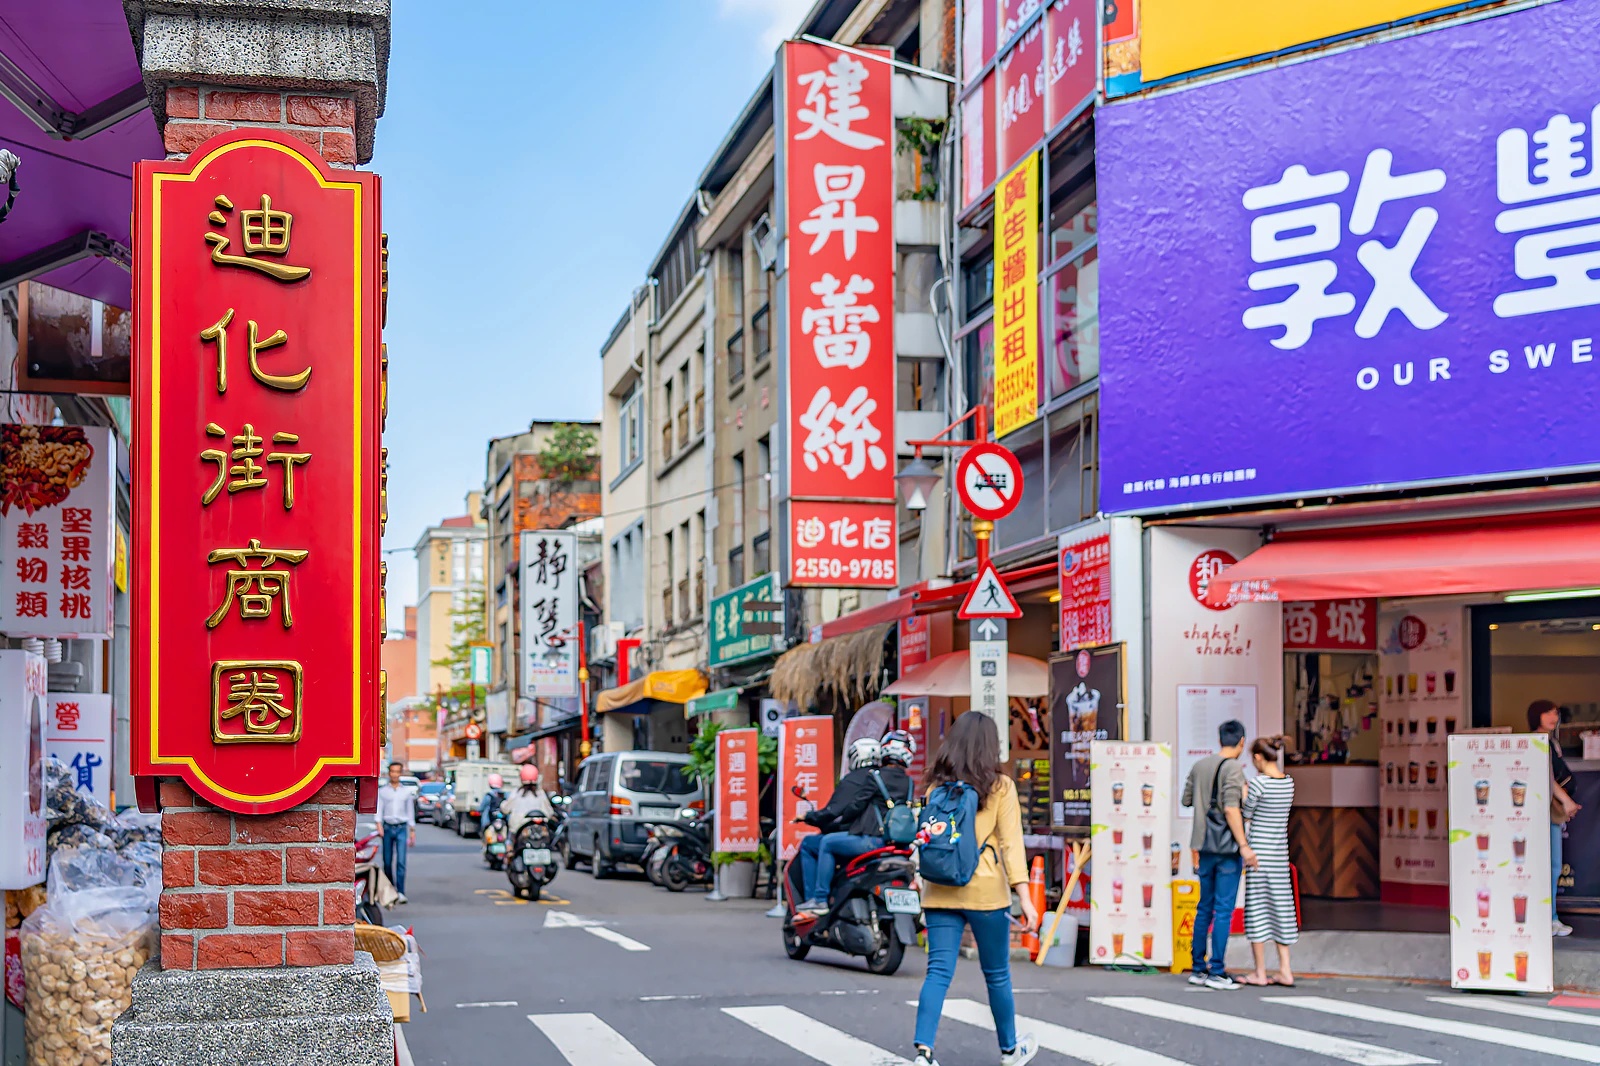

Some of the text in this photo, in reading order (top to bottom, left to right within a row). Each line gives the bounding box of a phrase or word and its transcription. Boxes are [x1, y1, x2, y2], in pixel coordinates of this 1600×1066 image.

[794, 53, 887, 480] 建昇蕾絲
[1356, 357, 1451, 390] OUR
[199, 193, 312, 744] 迪化街商圈
[796, 516, 892, 549] 迪化店
[16, 522, 48, 618] 穀物類
[60, 507, 92, 619] 堅果核桃
[795, 558, 894, 580] 2550-9785
[1183, 623, 1239, 642] shake!
[1283, 600, 1367, 645] 商城
[1196, 639, 1252, 656] shake!
